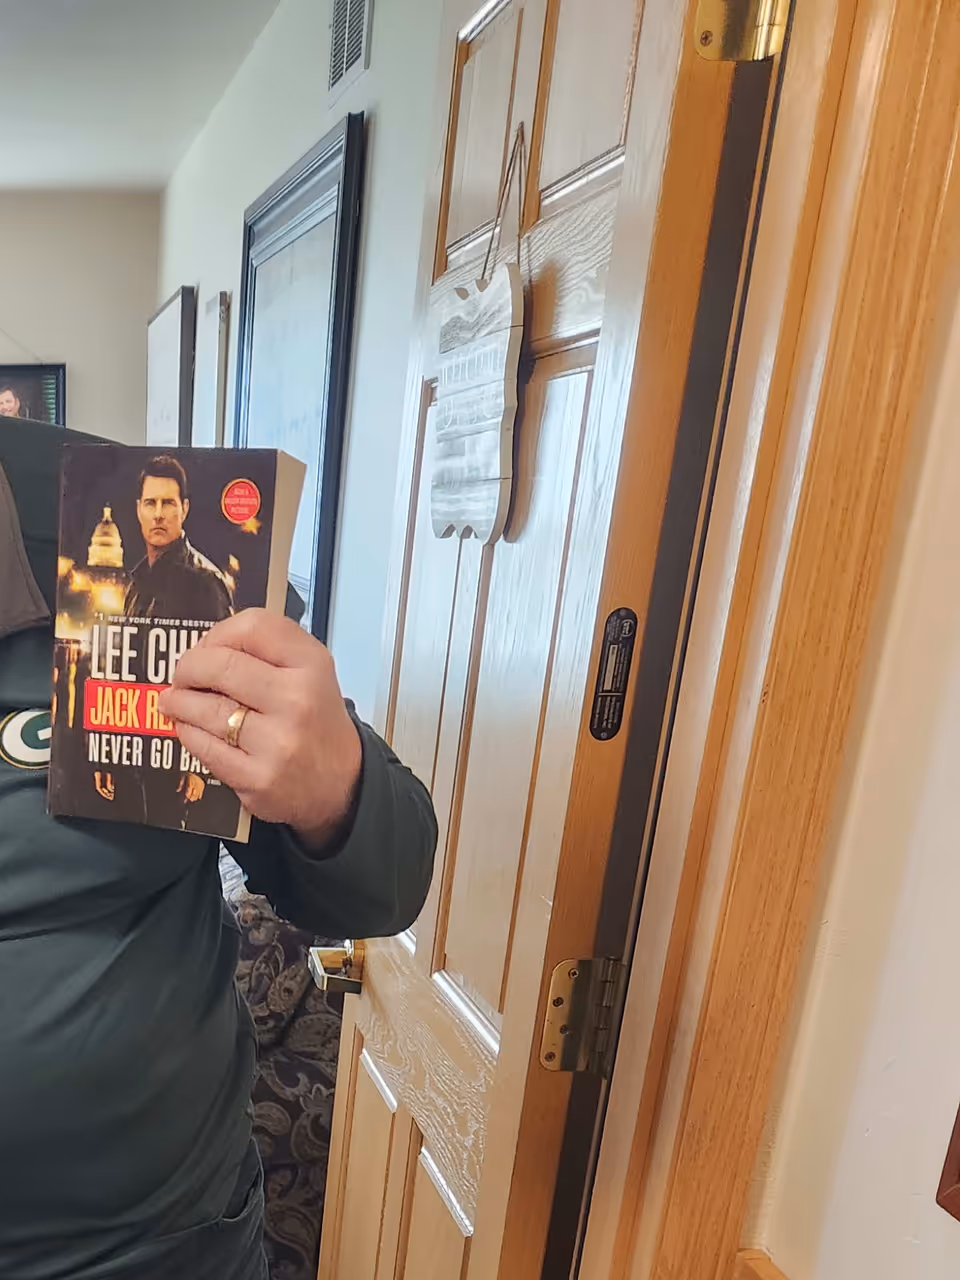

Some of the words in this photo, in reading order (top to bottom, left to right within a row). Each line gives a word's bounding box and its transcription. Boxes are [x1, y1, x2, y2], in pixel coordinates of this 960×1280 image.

[129, 617, 151, 625] YORK
[154, 618, 180, 626] TIMES
[182, 619, 217, 628] BESTSE
[90, 624, 138, 682] LEE
[90, 686, 141, 729] JACK
[88, 733, 143, 766] NEVER
[150, 738, 173, 769] GO
